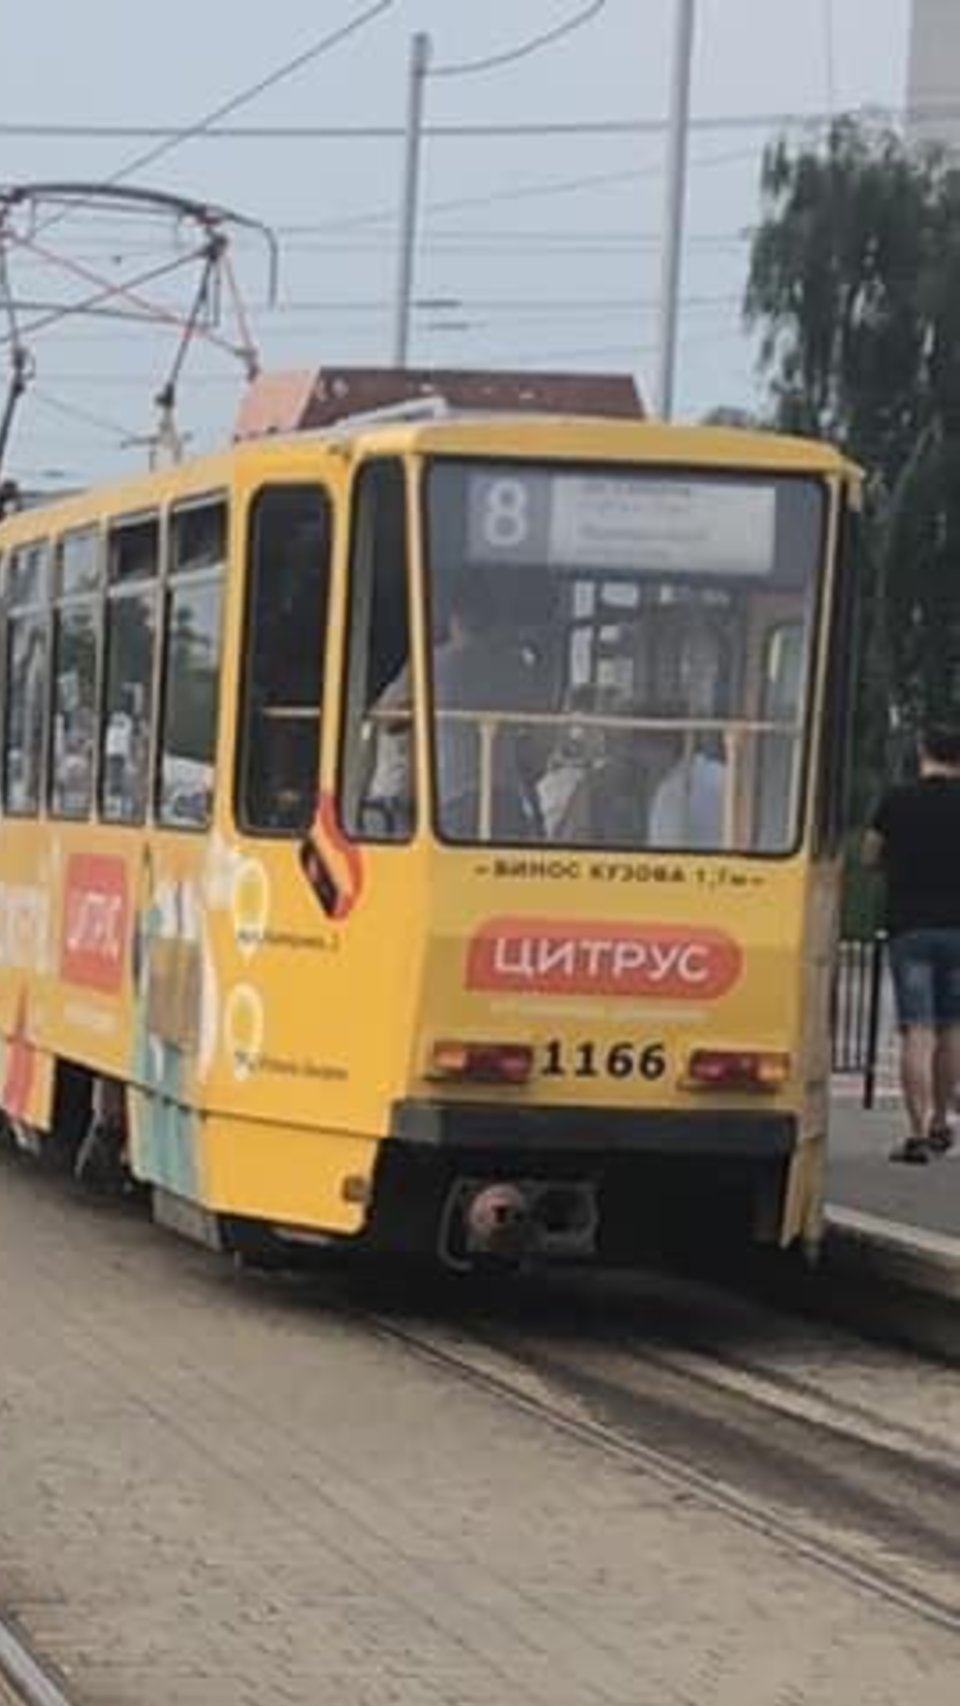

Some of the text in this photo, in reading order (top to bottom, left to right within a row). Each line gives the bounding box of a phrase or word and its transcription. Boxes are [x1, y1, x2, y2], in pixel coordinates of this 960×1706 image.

[484, 478, 527, 547] 8
[493, 938, 710, 982] ЦИТРУС
[542, 1038, 666, 1079] 1166
